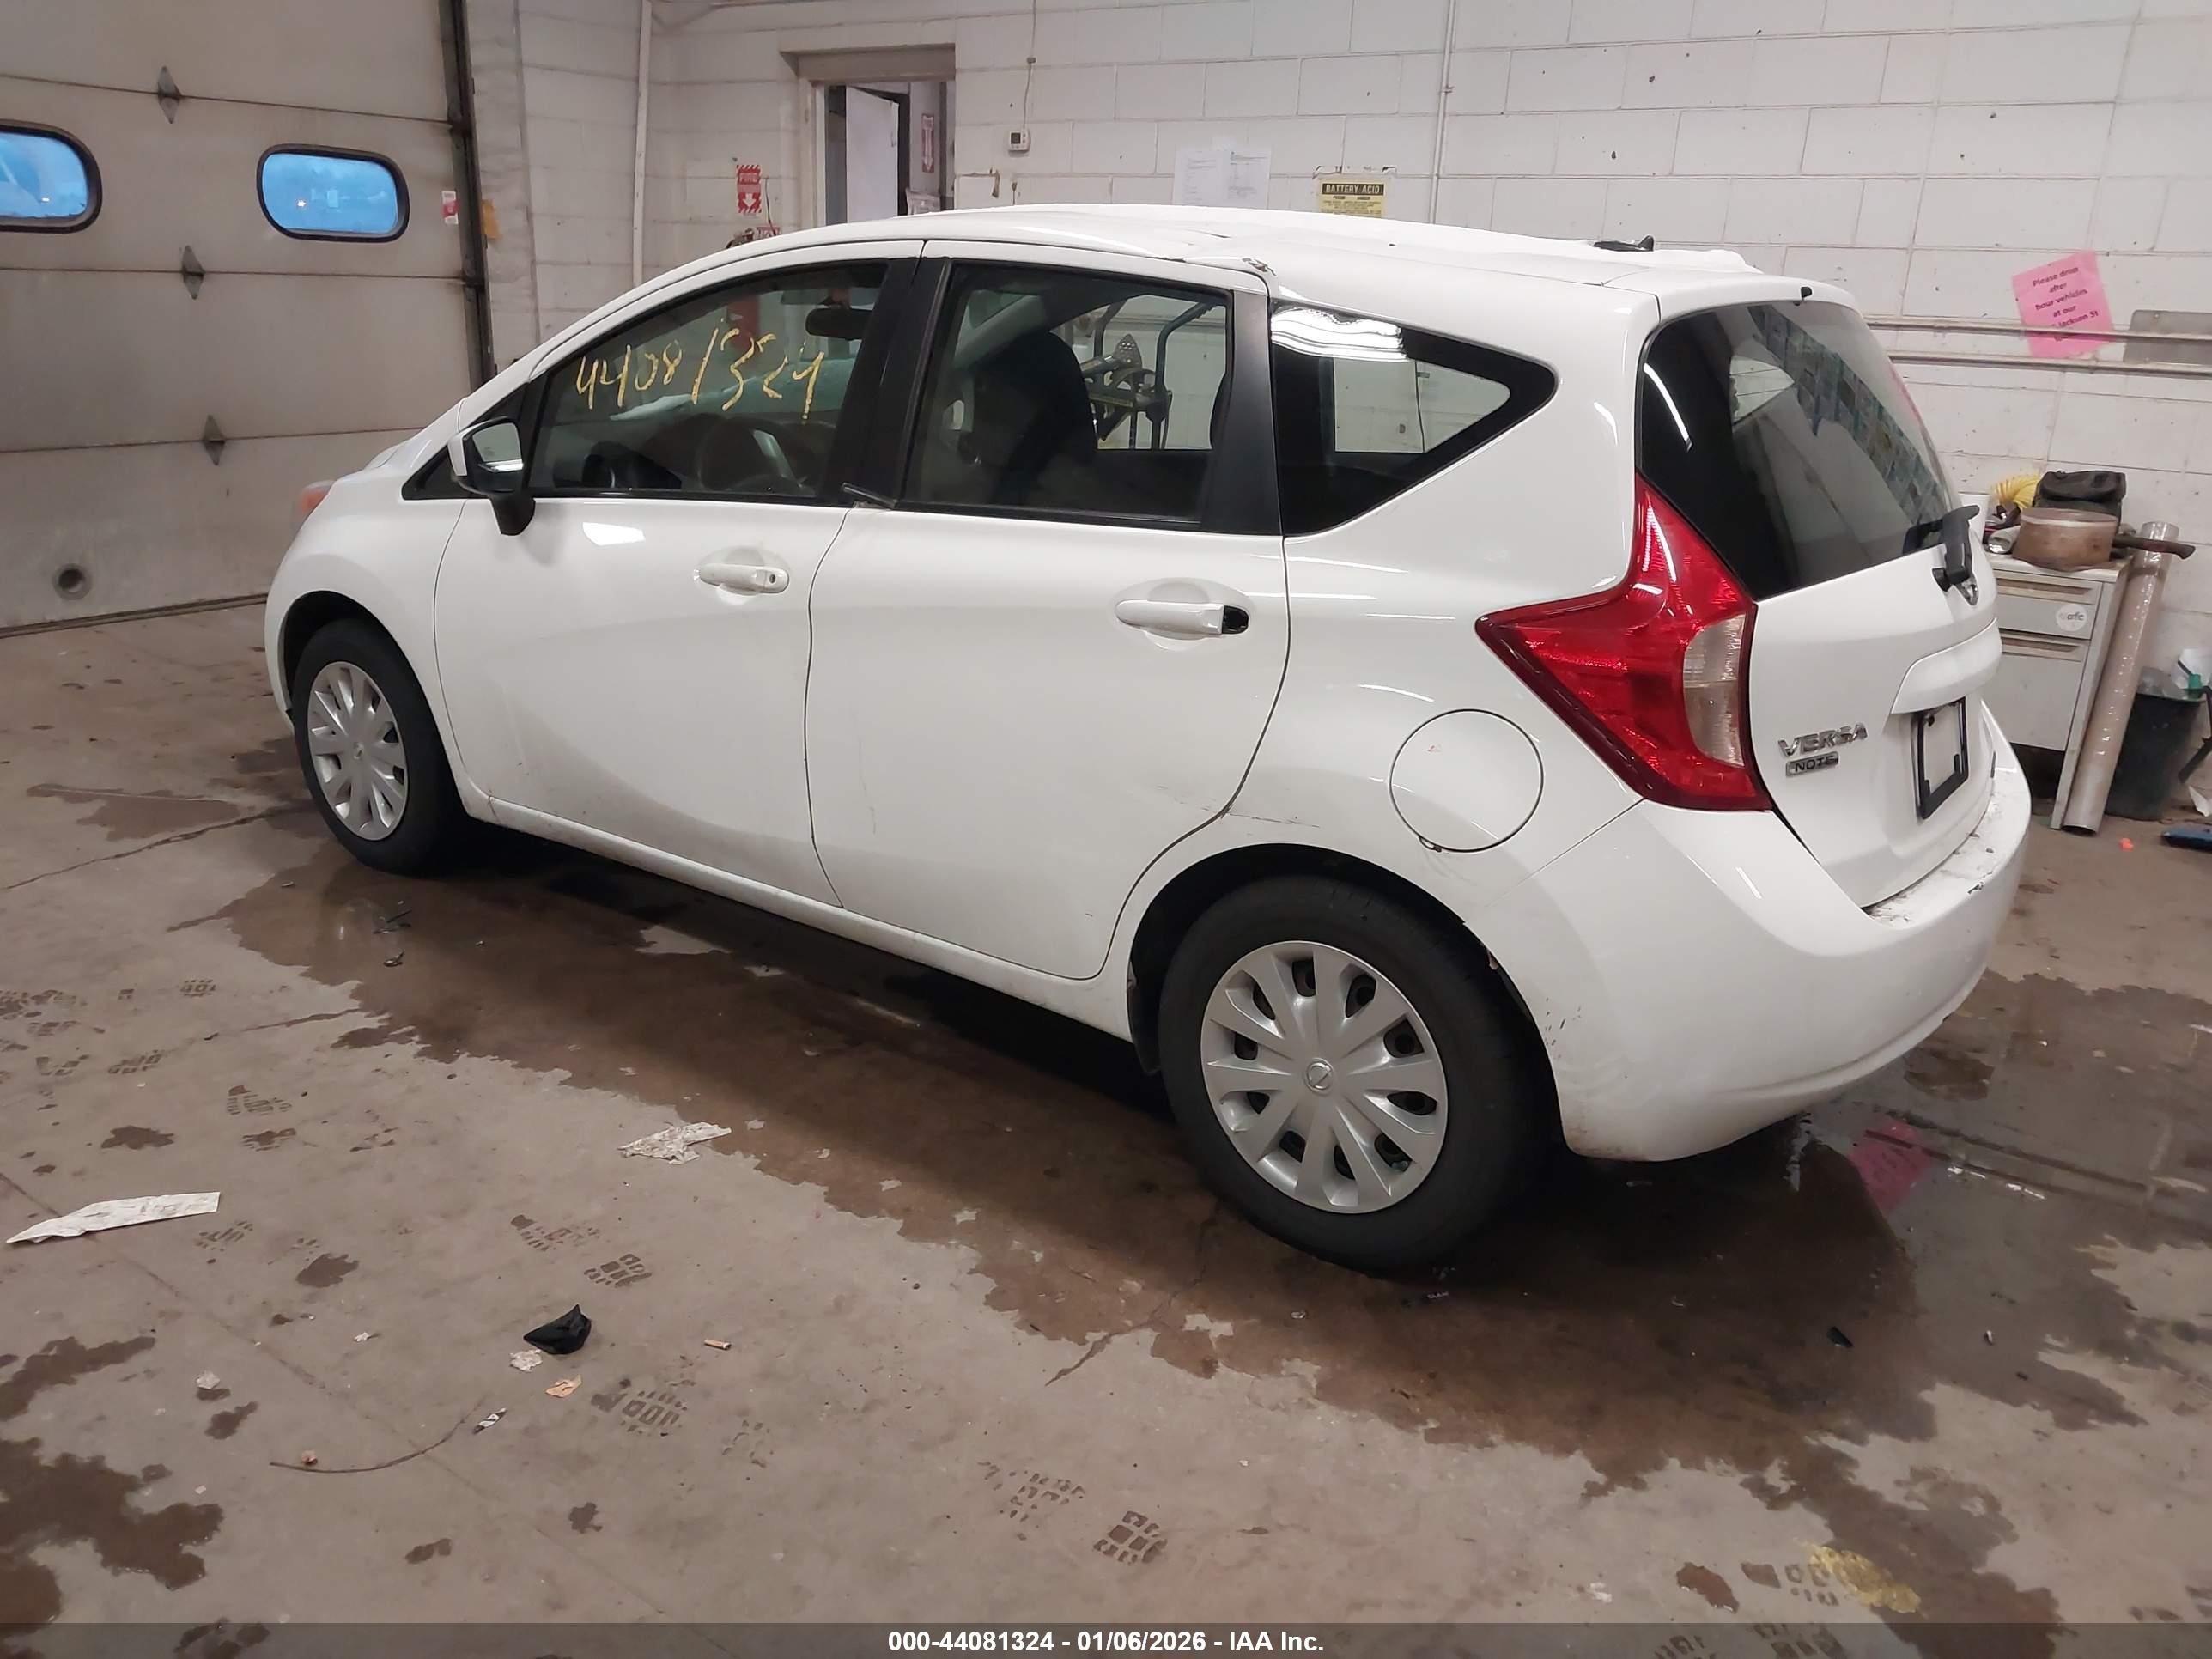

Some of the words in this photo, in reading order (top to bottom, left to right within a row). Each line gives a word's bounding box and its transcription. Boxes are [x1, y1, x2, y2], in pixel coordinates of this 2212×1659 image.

[1326, 185, 1359, 194] BATTERY
[1362, 185, 1380, 194] ACID
[2033, 274, 2057, 287] Please
[2059, 267, 2079, 277] drop
[2049, 283, 2067, 293] after
[2035, 301, 2054, 311] hour
[2055, 289, 2087, 303] vehicles
[2063, 306, 2076, 314] our
[1778, 722, 1869, 757] VERSA
[1793, 754, 1838, 773] NOTE
